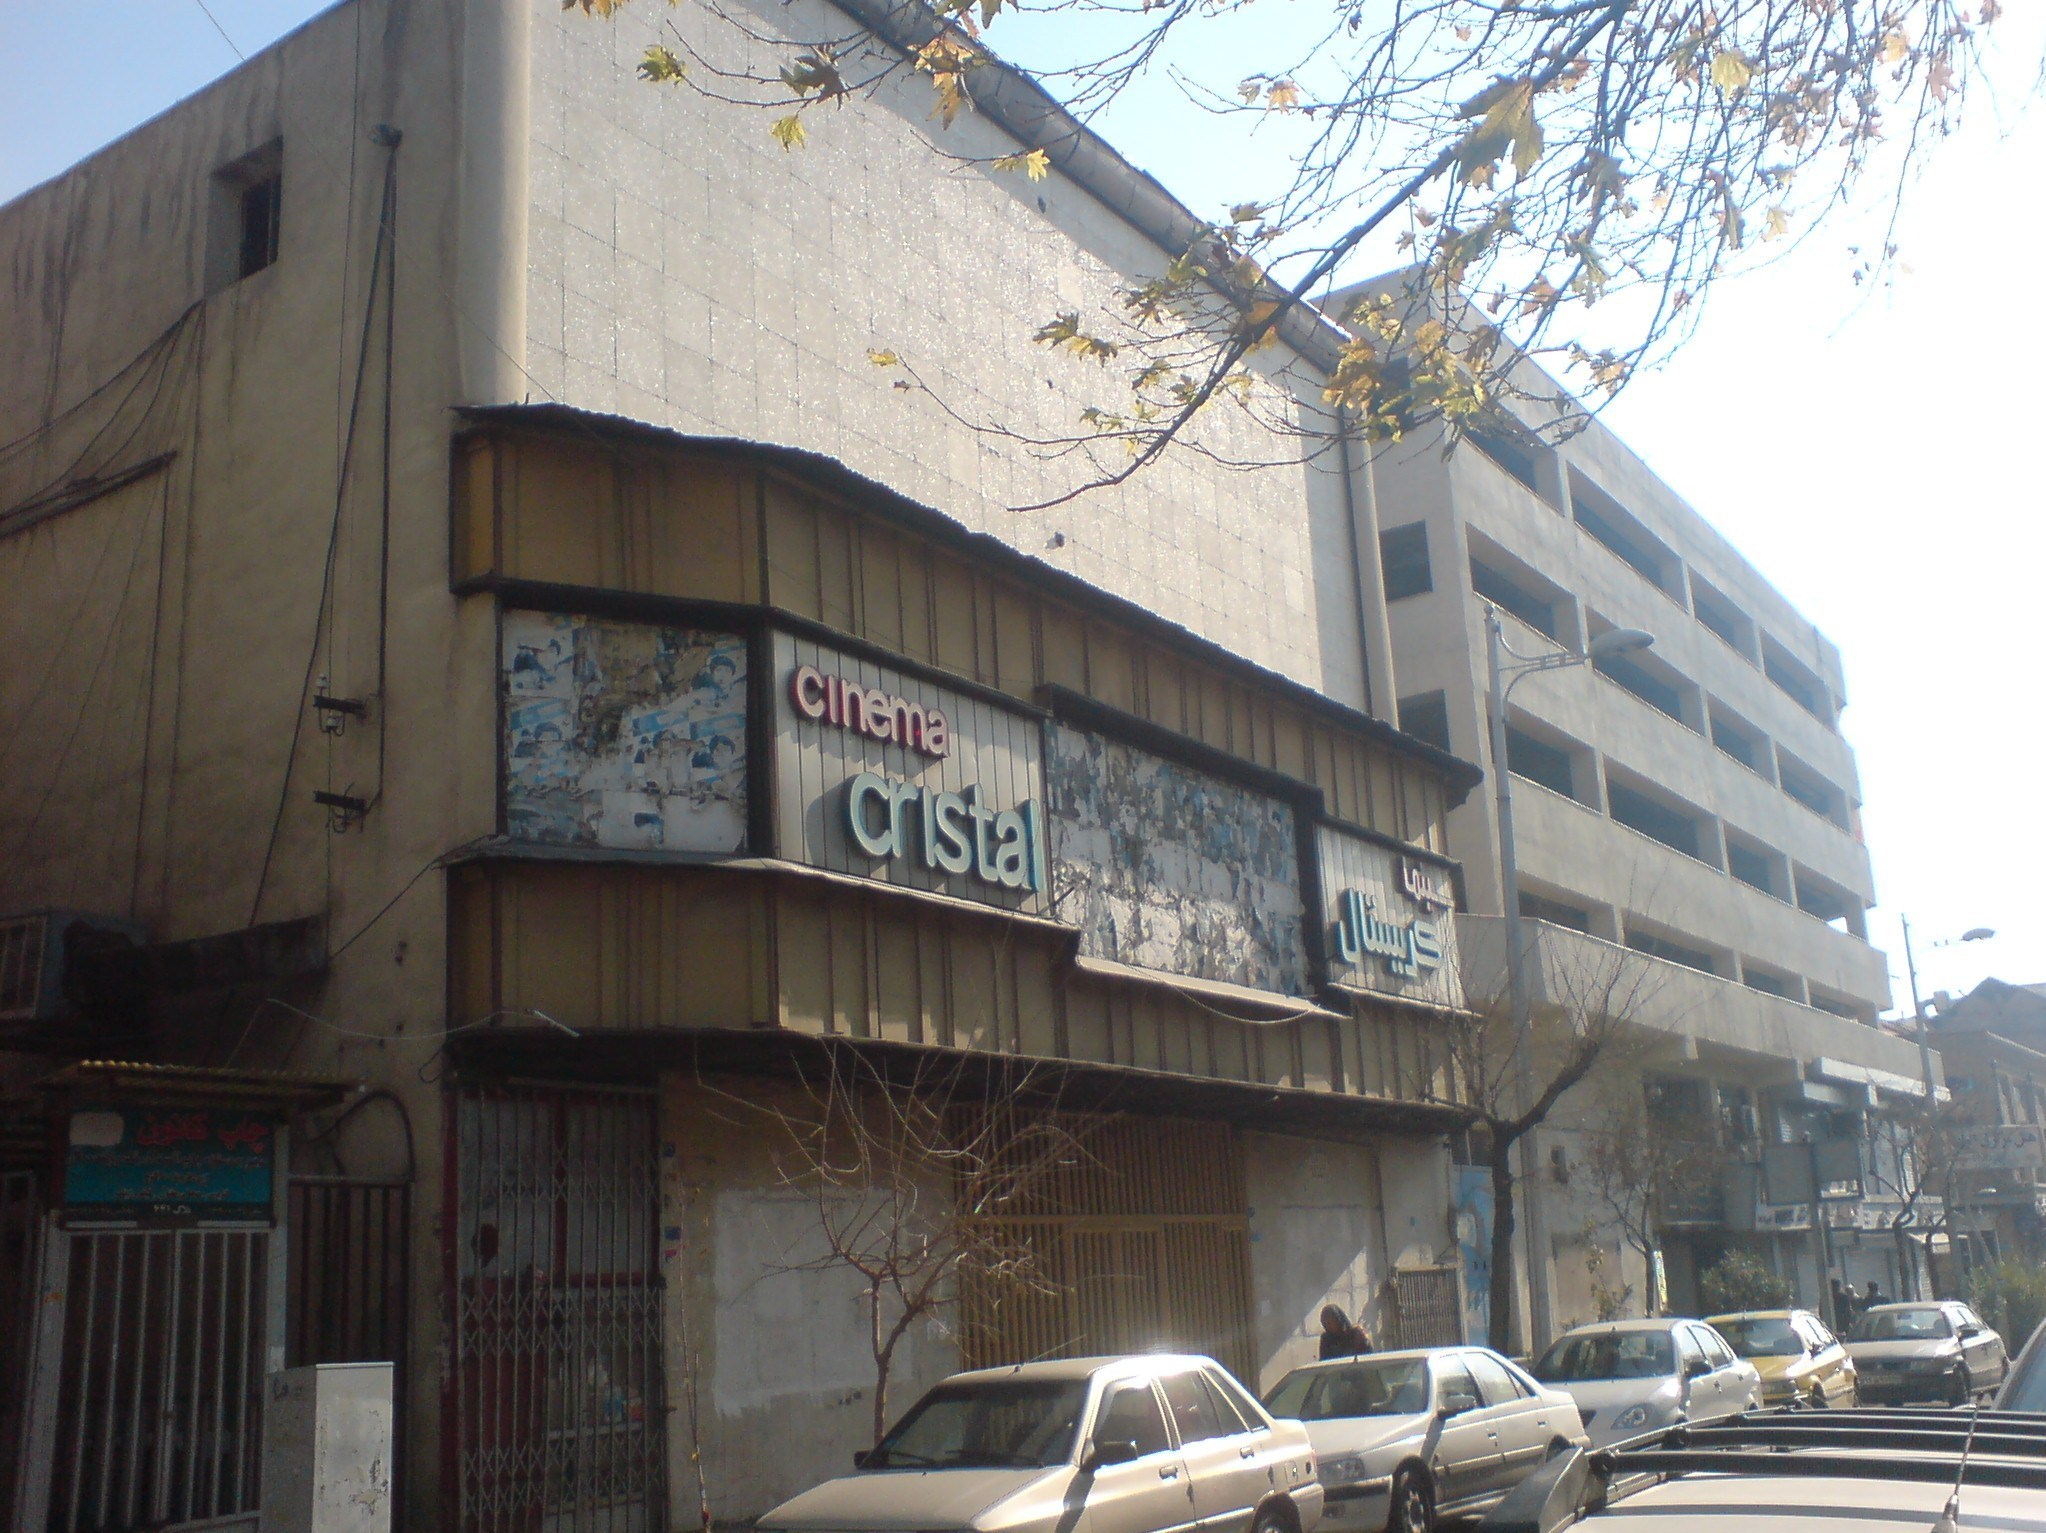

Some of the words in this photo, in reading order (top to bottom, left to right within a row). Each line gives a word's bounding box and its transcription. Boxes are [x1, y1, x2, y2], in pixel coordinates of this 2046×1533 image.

[791, 665, 951, 758] cinema
[847, 771, 1045, 893] cristal
[1400, 855, 1455, 913] سینما
[1337, 887, 1443, 978] کریستال
